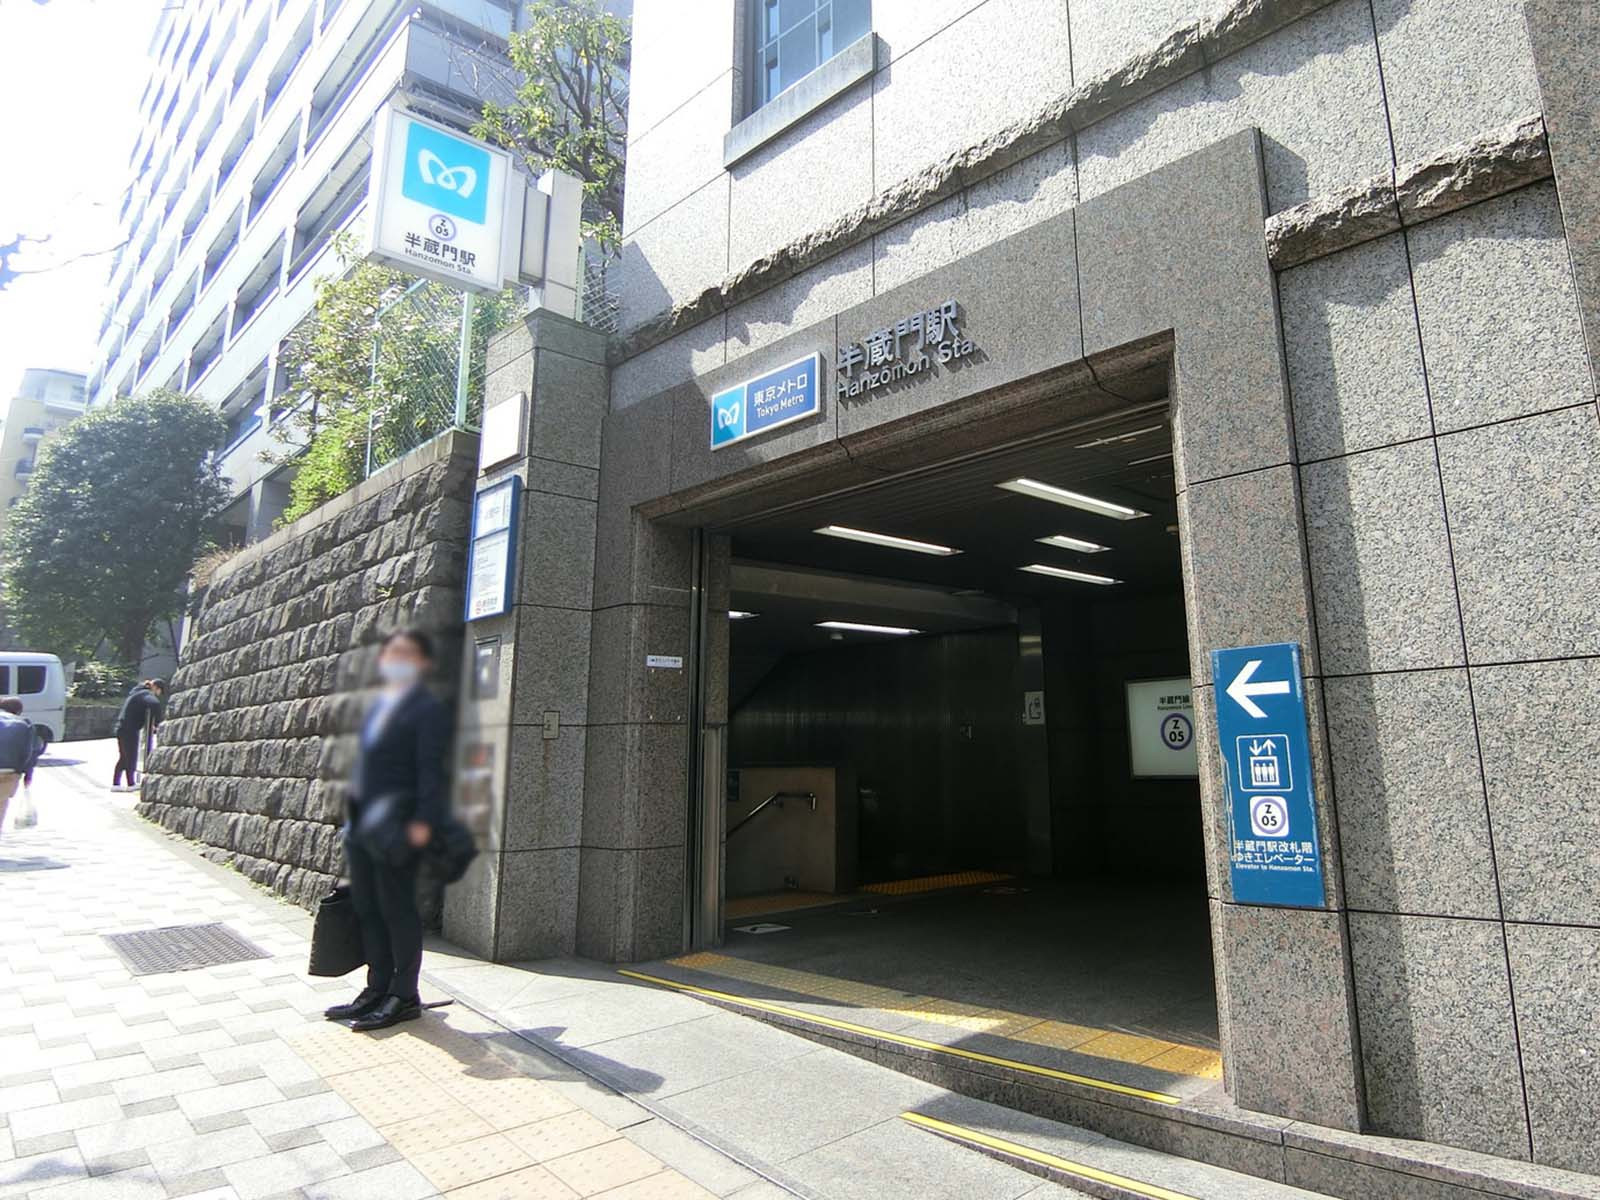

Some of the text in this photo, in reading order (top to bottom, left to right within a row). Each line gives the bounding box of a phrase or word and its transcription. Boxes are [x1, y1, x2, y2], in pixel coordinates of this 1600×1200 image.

[440, 219, 446, 227] Z
[435, 226, 449, 236] 05
[404, 232, 476, 268] 半蔵門駅
[405, 248, 455, 269] Hanzomon
[837, 299, 959, 377] 半蔵門駅
[754, 373, 807, 407] 東京メトロ
[757, 394, 805, 418] Tokyo Metro
[1172, 720, 1180, 729] Z
[1169, 731, 1185, 743] 05
[1264, 804, 1273, 814] Z
[1261, 815, 1278, 827] 05
